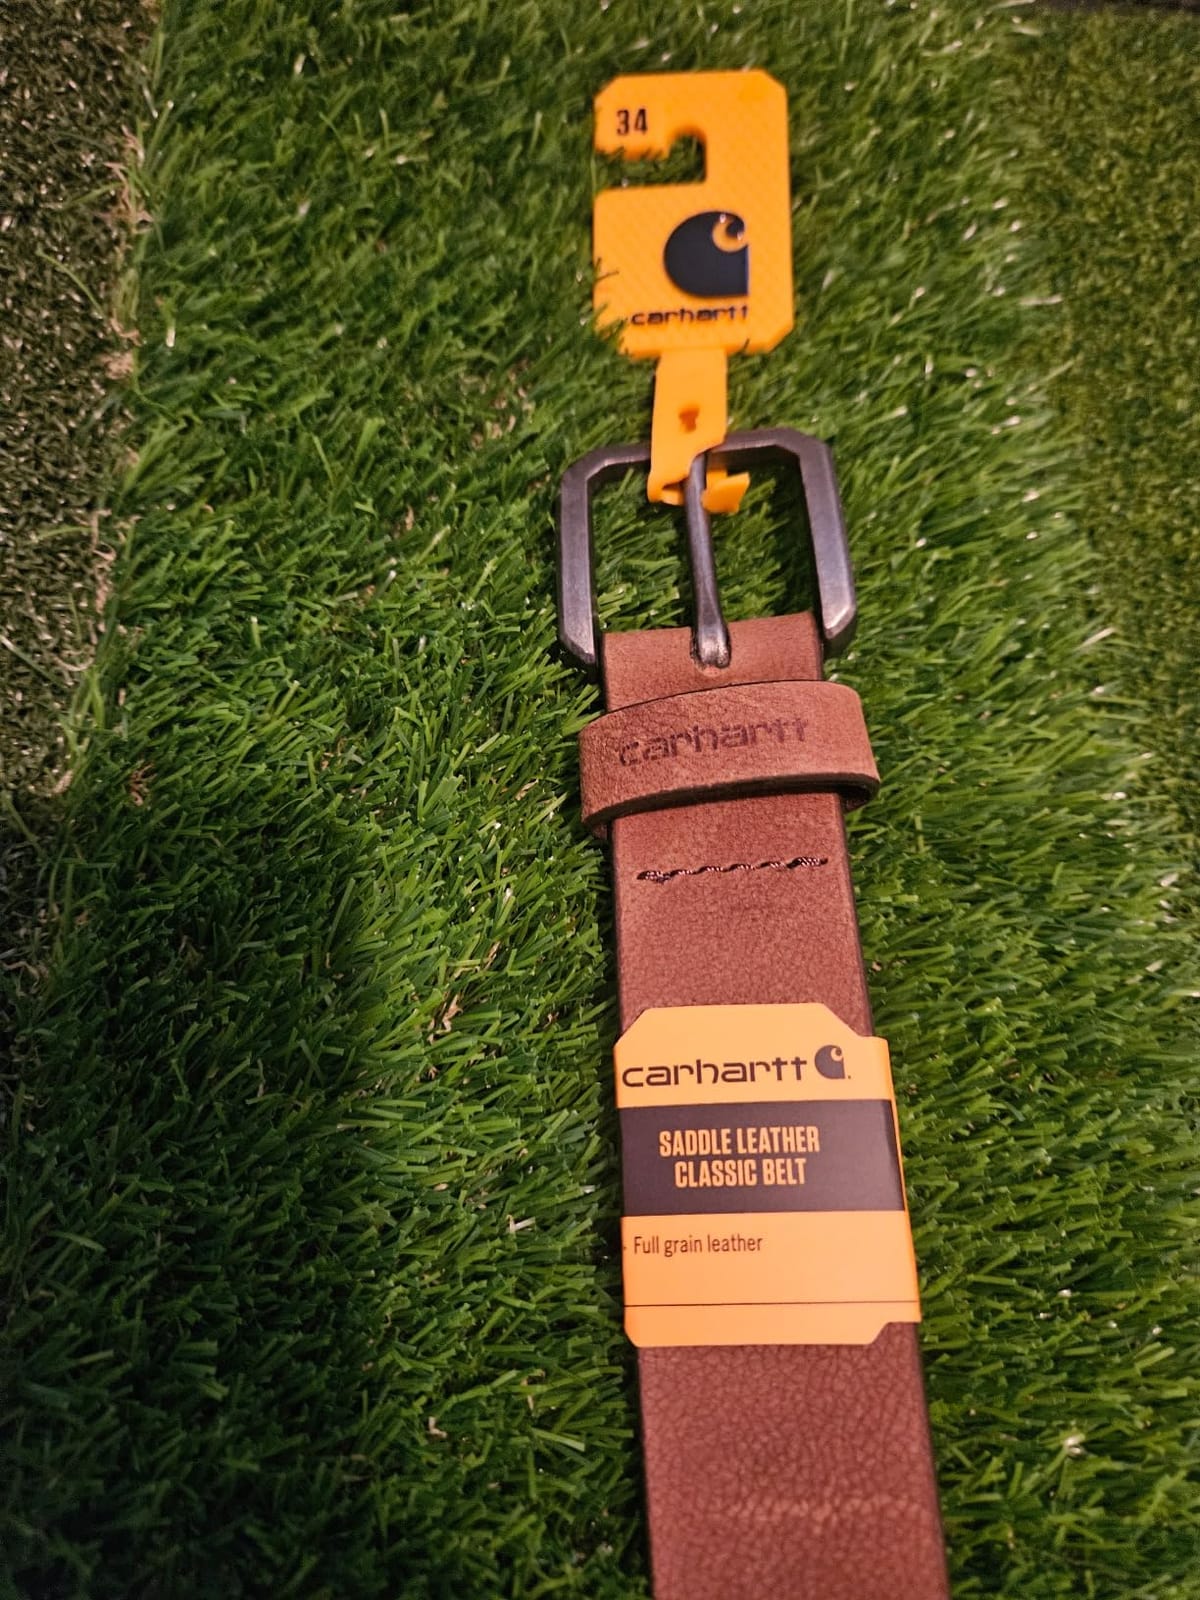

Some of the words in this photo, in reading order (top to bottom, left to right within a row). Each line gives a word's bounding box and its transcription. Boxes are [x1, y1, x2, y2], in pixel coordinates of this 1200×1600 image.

[616, 107, 648, 136] 34
[630, 304, 748, 326] carhartt
[618, 717, 808, 766] carhartt
[621, 1056, 808, 1088] carhartt
[658, 1127, 732, 1158] SADDLE
[736, 1125, 821, 1154] LEATHER
[674, 1158, 758, 1188] CLASSIC
[762, 1157, 808, 1186] BELT
[633, 1235, 660, 1255] Full
[663, 1235, 703, 1257] grain
[706, 1233, 764, 1253] leather
